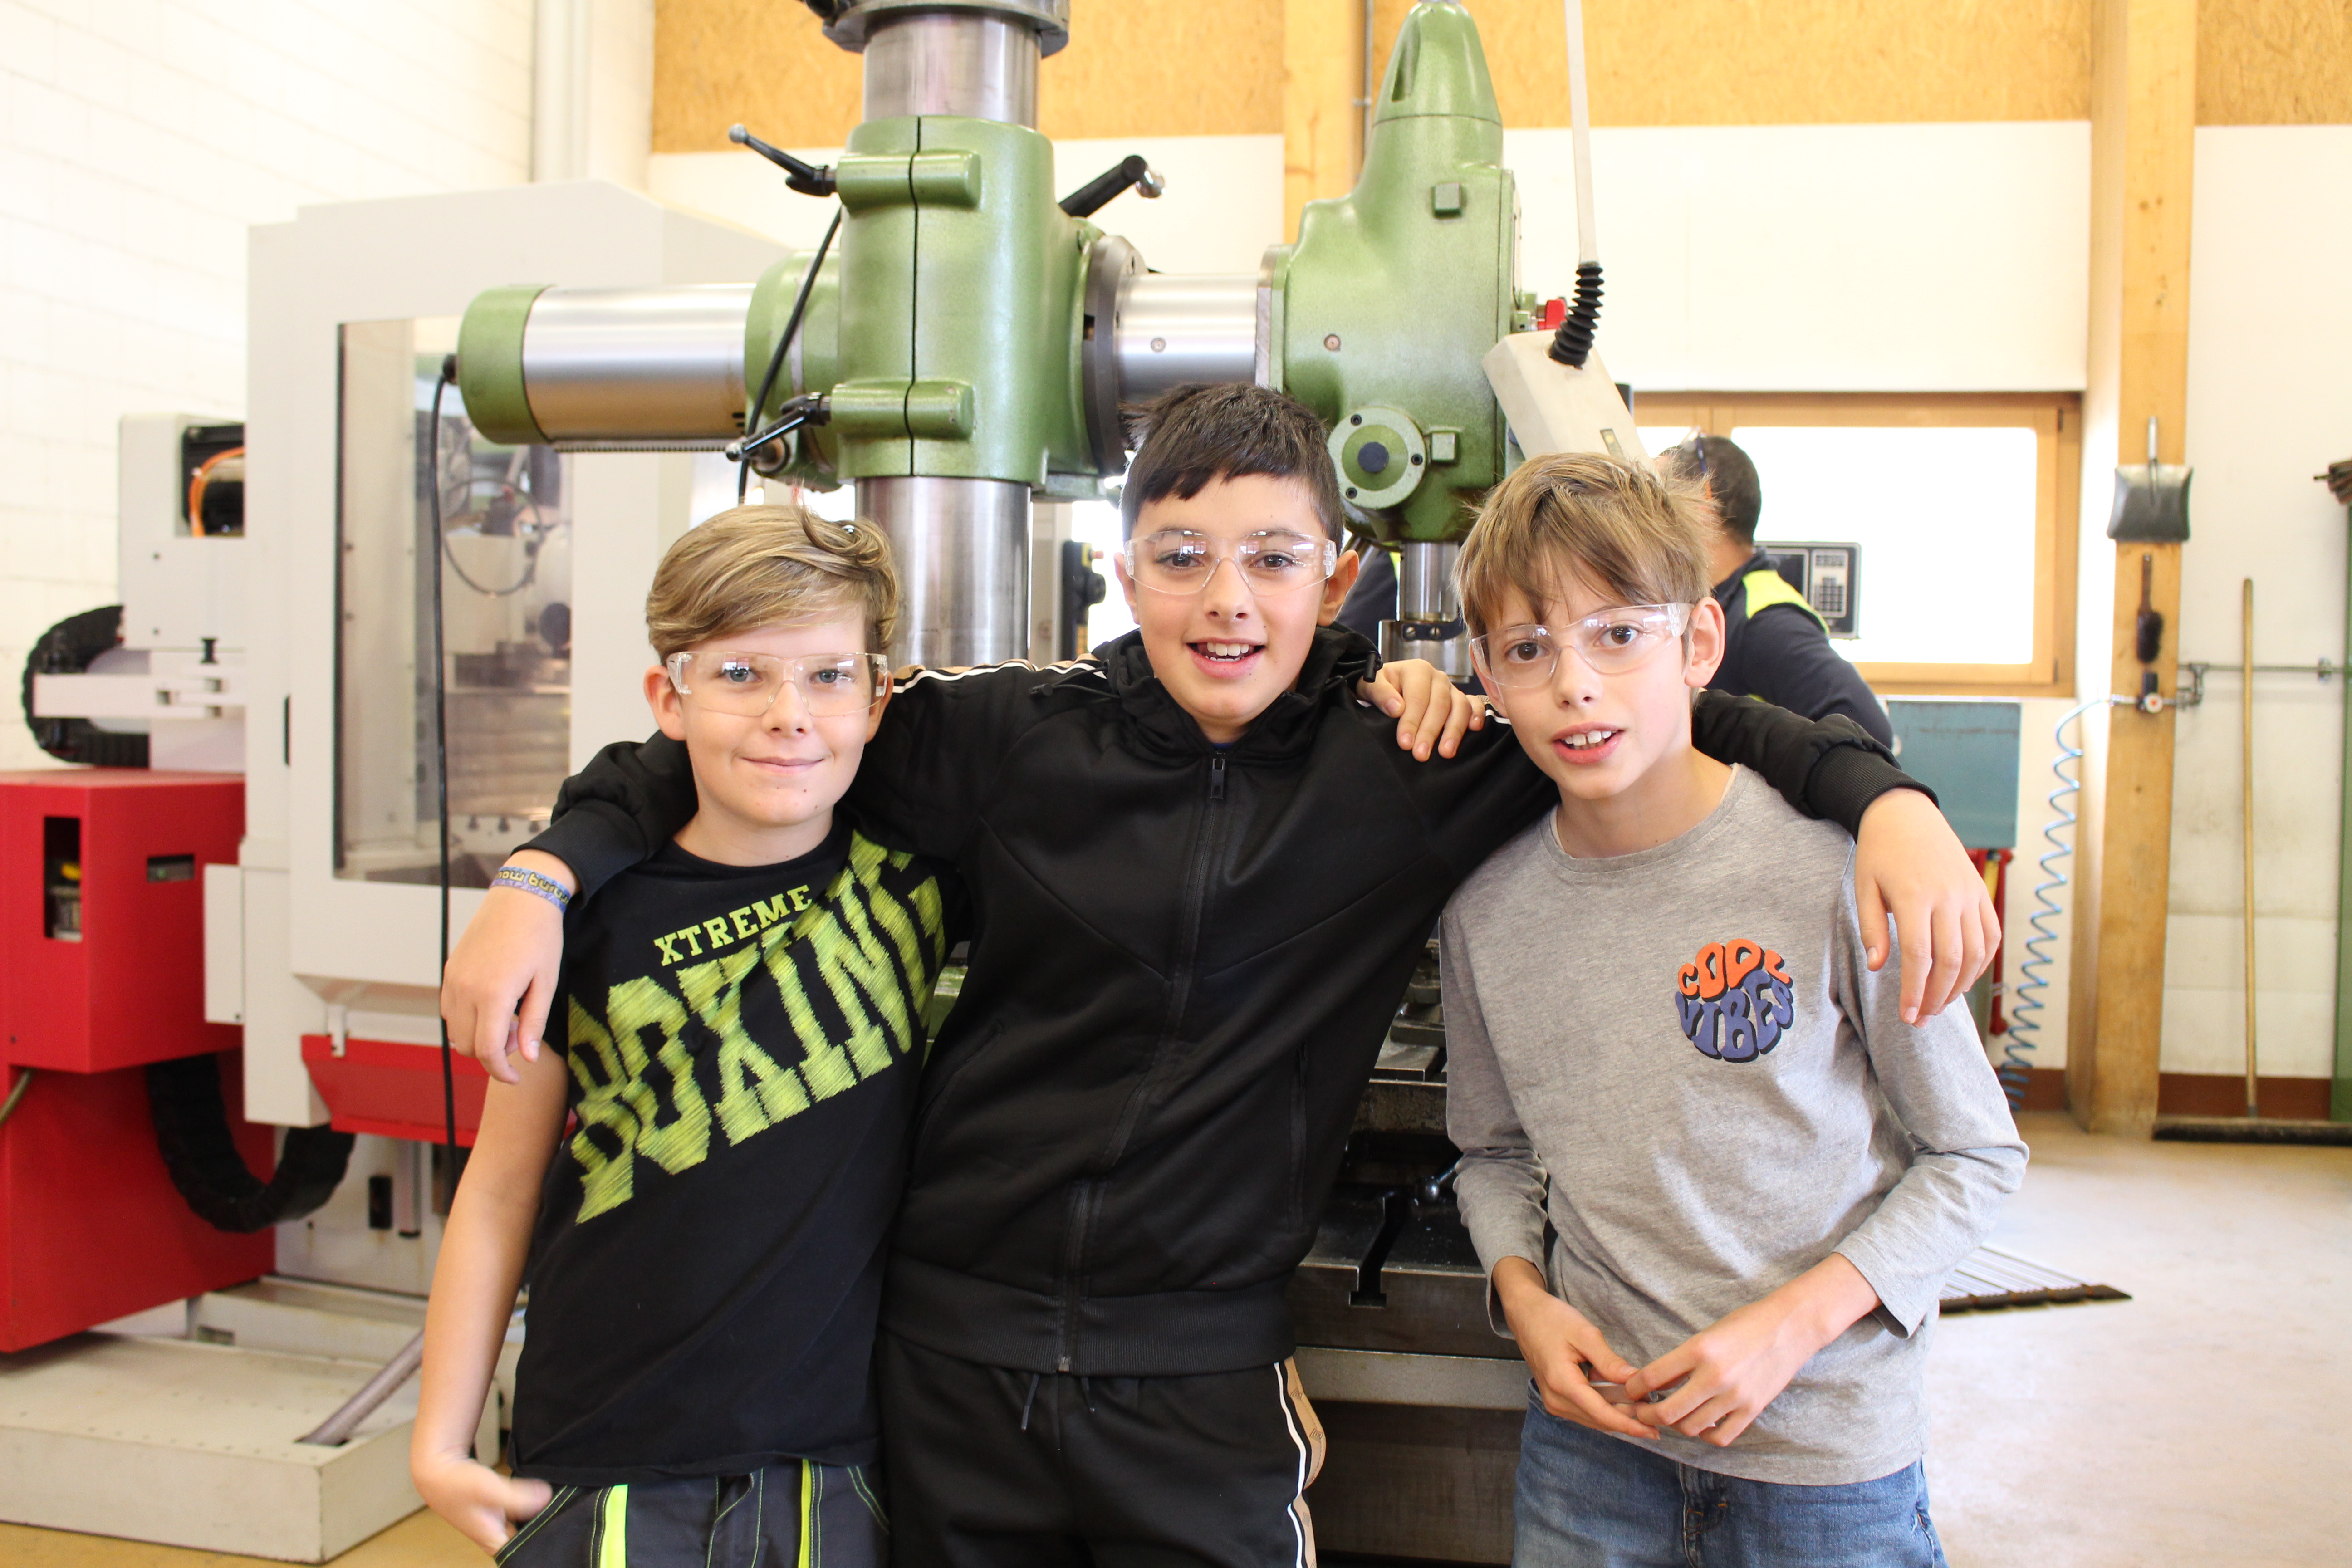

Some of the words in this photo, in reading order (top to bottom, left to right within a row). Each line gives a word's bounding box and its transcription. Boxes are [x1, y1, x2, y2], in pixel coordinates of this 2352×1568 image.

[654, 885, 813, 966] XTREME
[568, 829, 946, 1226] BOXING
[1675, 970, 1793, 1063] VIBES
